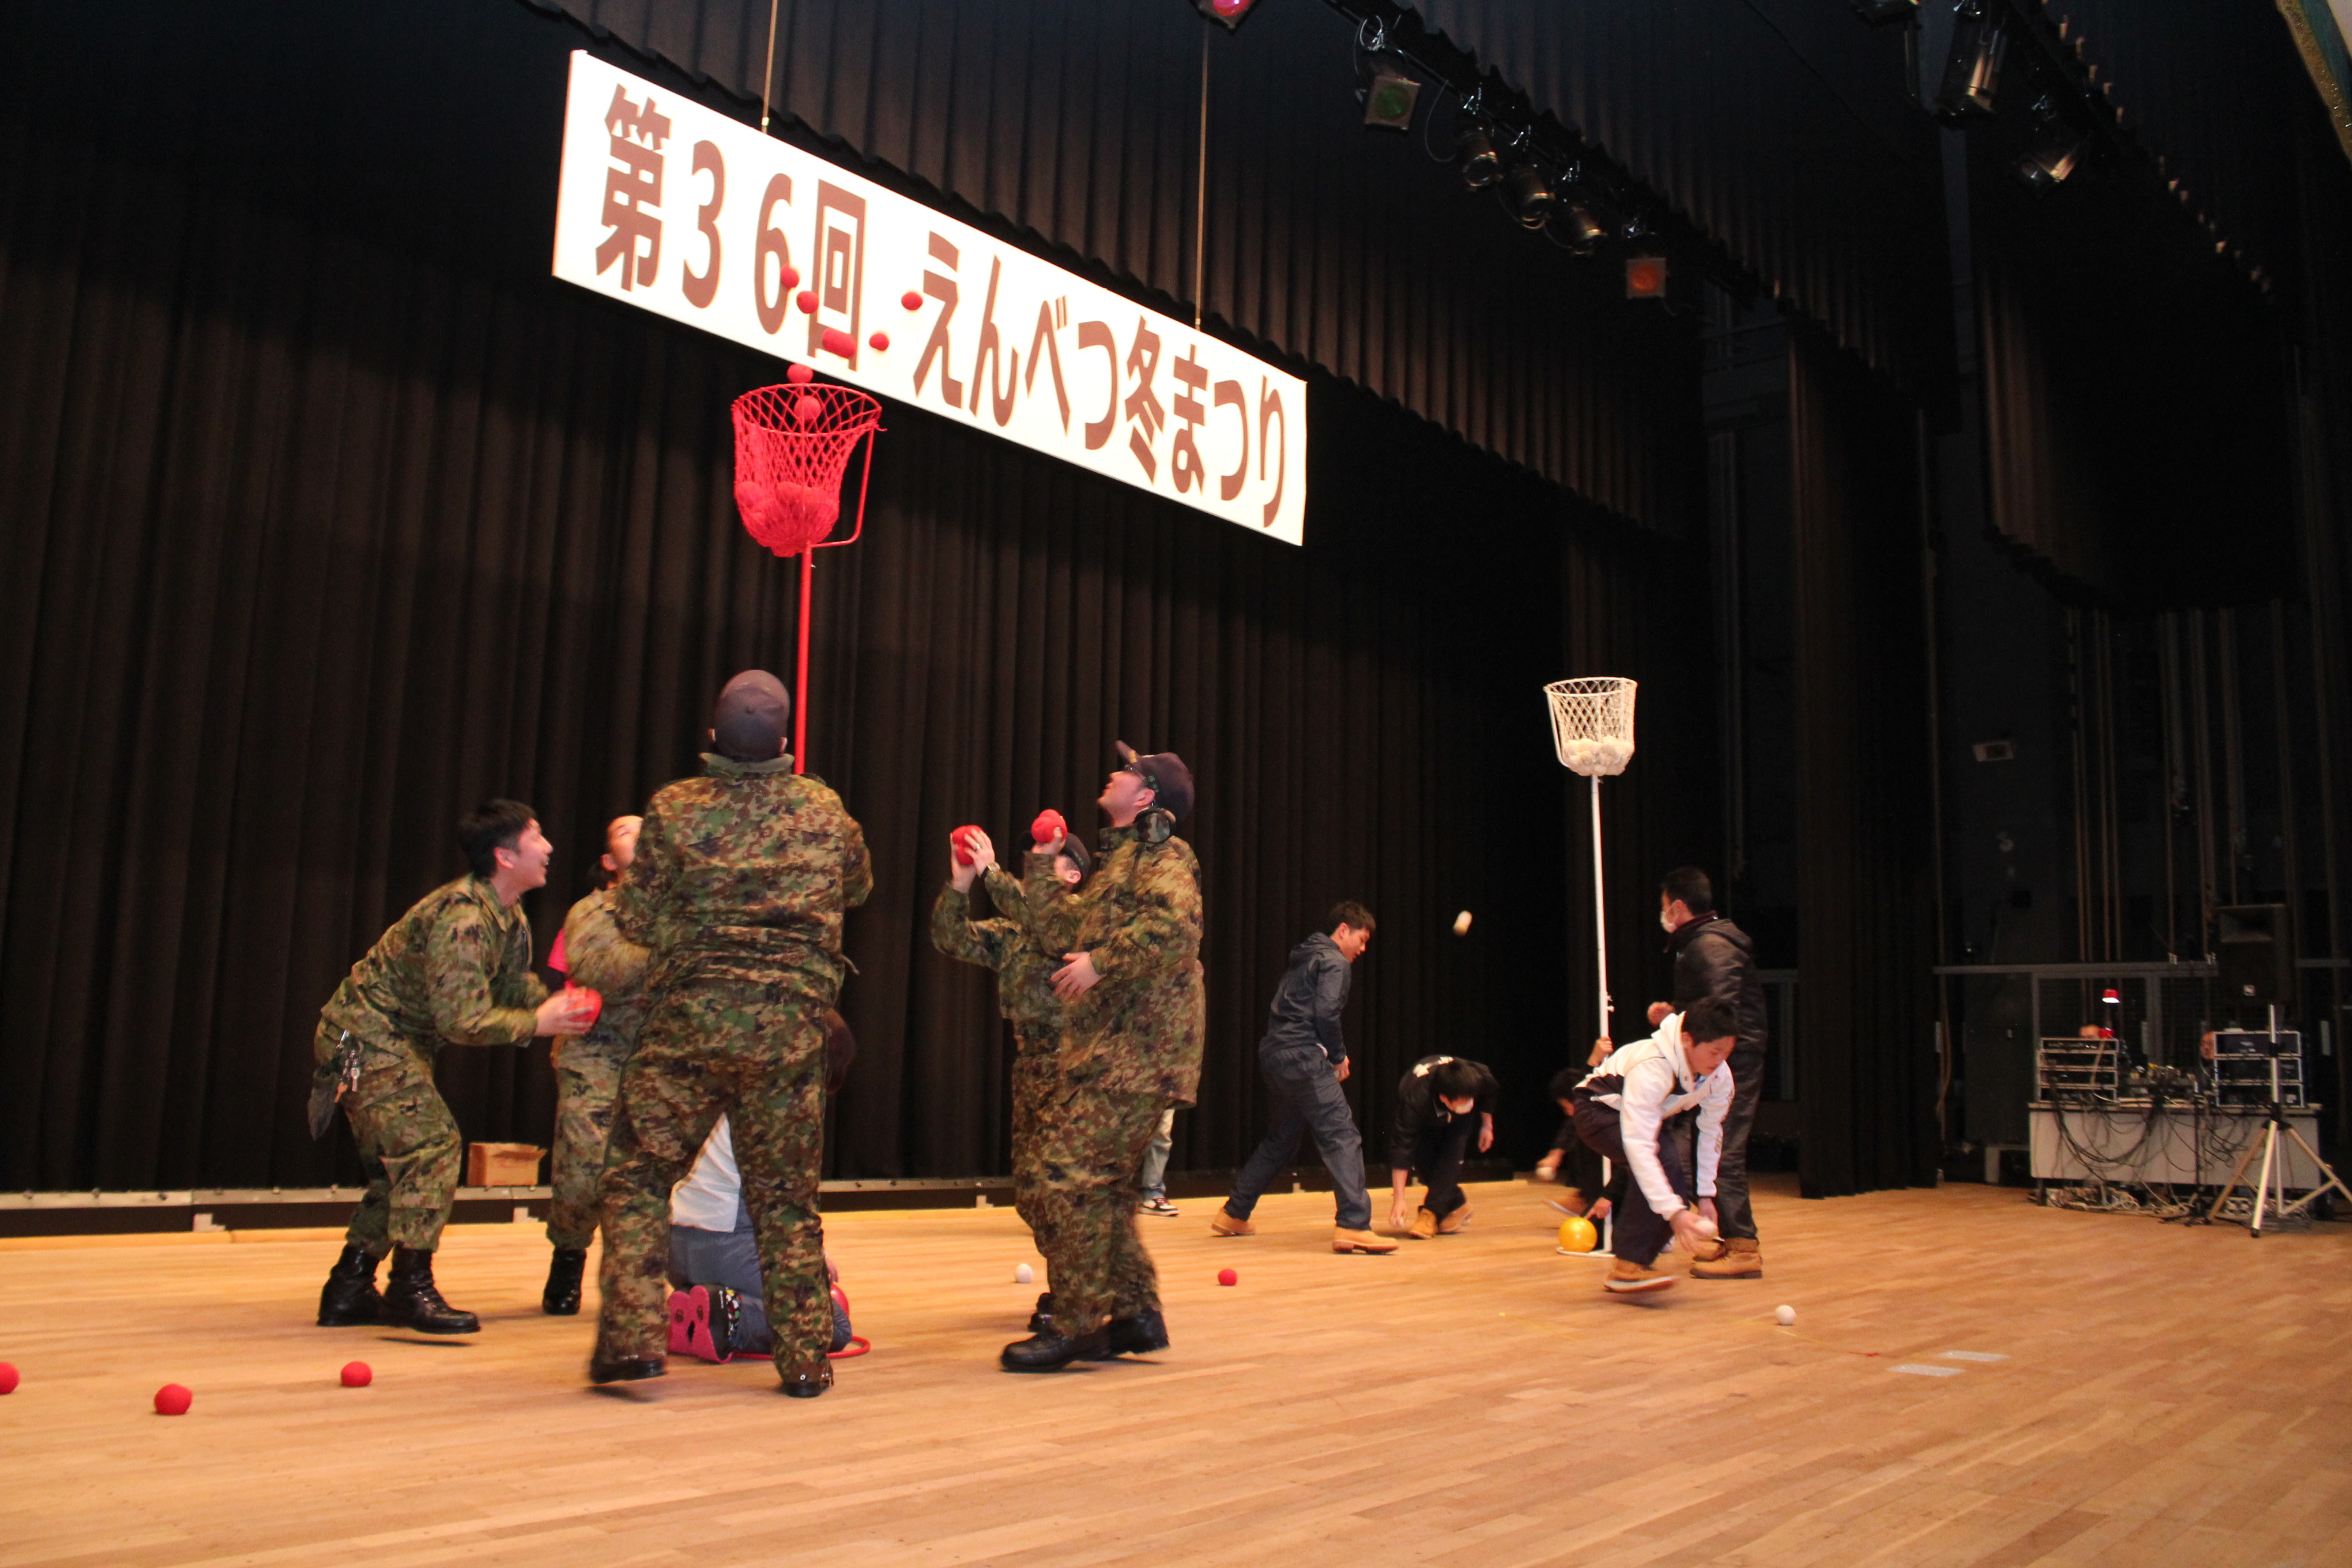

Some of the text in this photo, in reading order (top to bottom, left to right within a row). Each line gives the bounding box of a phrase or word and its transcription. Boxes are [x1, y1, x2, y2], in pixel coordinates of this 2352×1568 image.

[595, 83, 1285, 528] 第36回 えんべつ冬まつり
